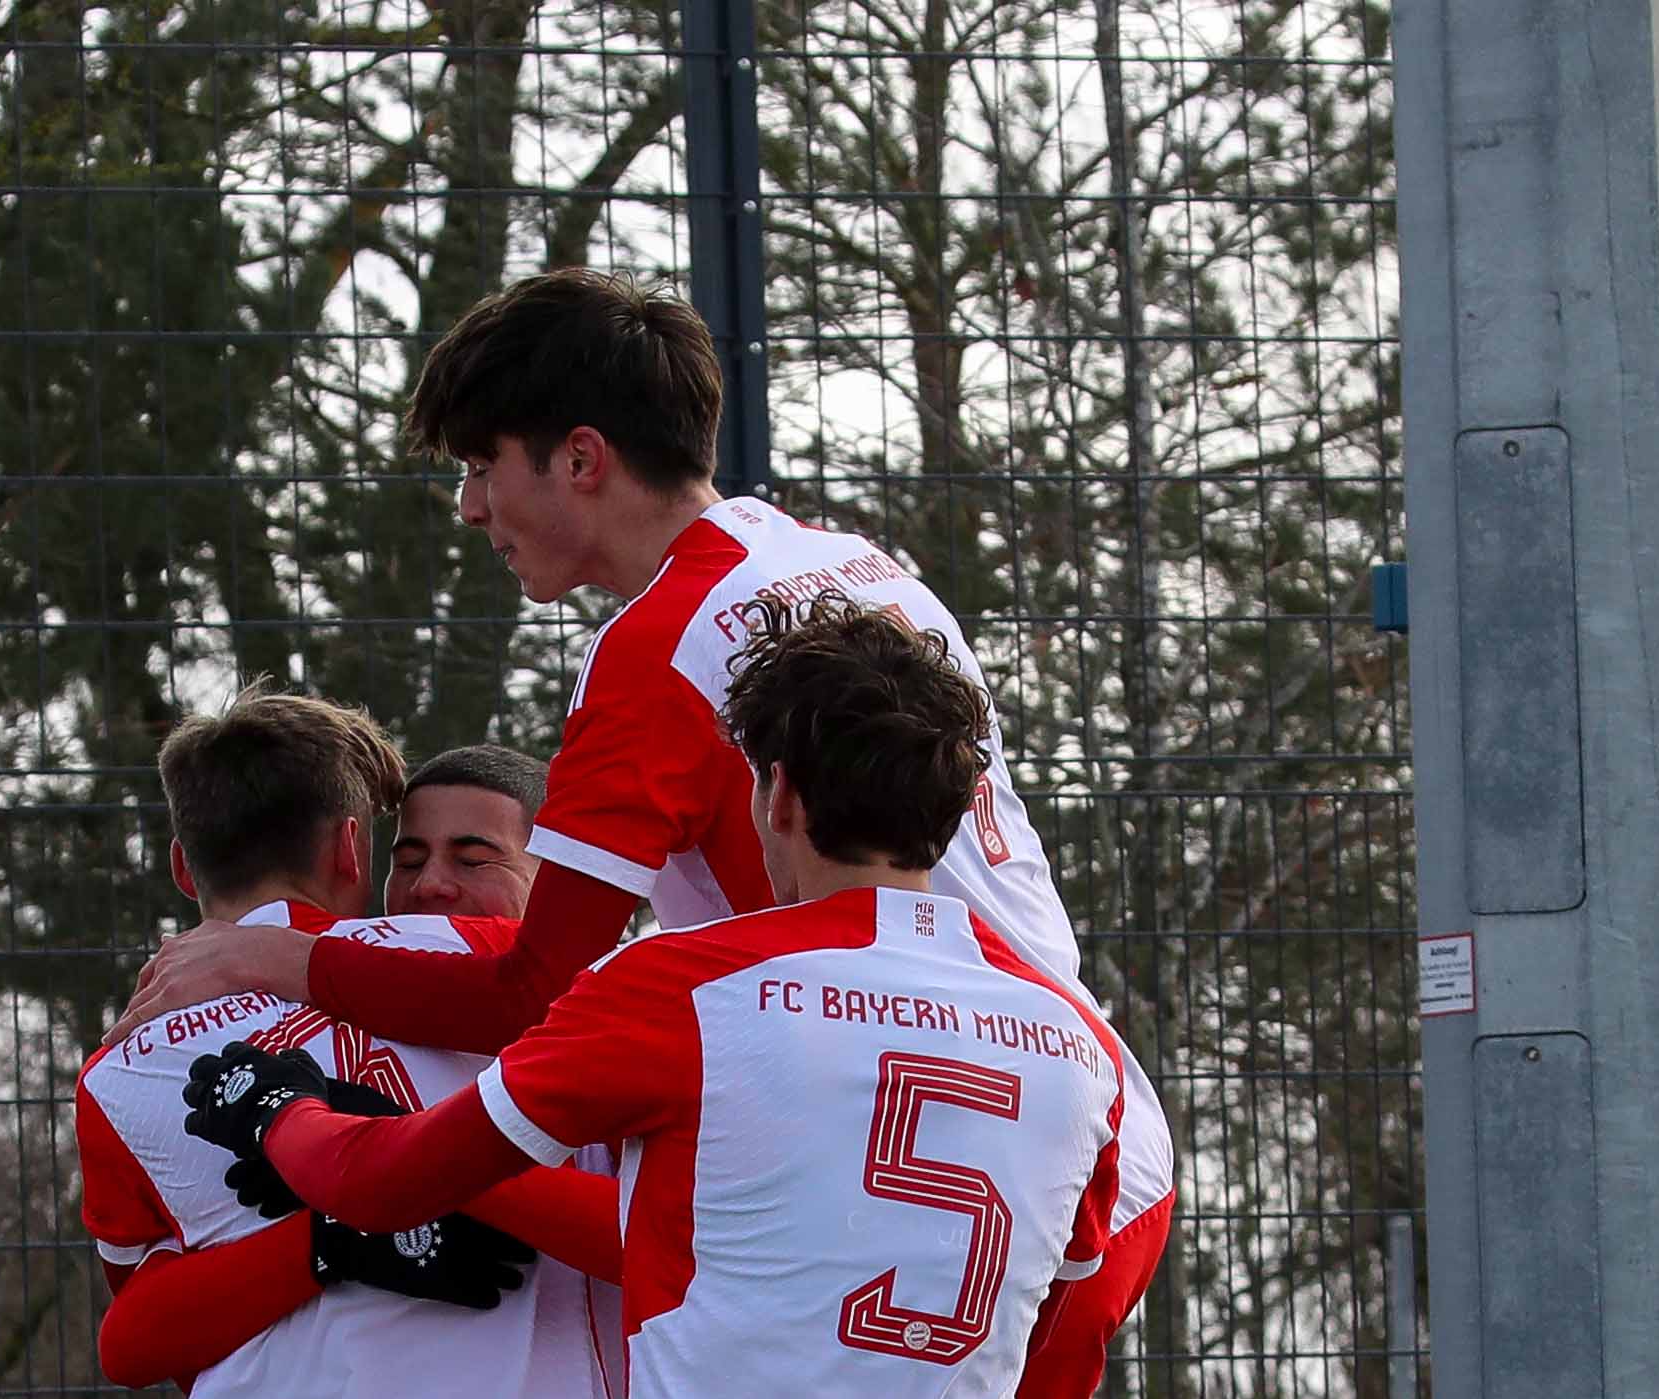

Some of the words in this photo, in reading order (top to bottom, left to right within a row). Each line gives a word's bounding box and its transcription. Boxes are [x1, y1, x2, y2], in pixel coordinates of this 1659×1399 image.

[122, 1026, 154, 1067] FC
[758, 980, 804, 1014] FC
[822, 986, 960, 1032] BAYERN
[972, 1009, 1100, 1078] MÜNCHEN
[838, 1051, 1022, 1367] 5
